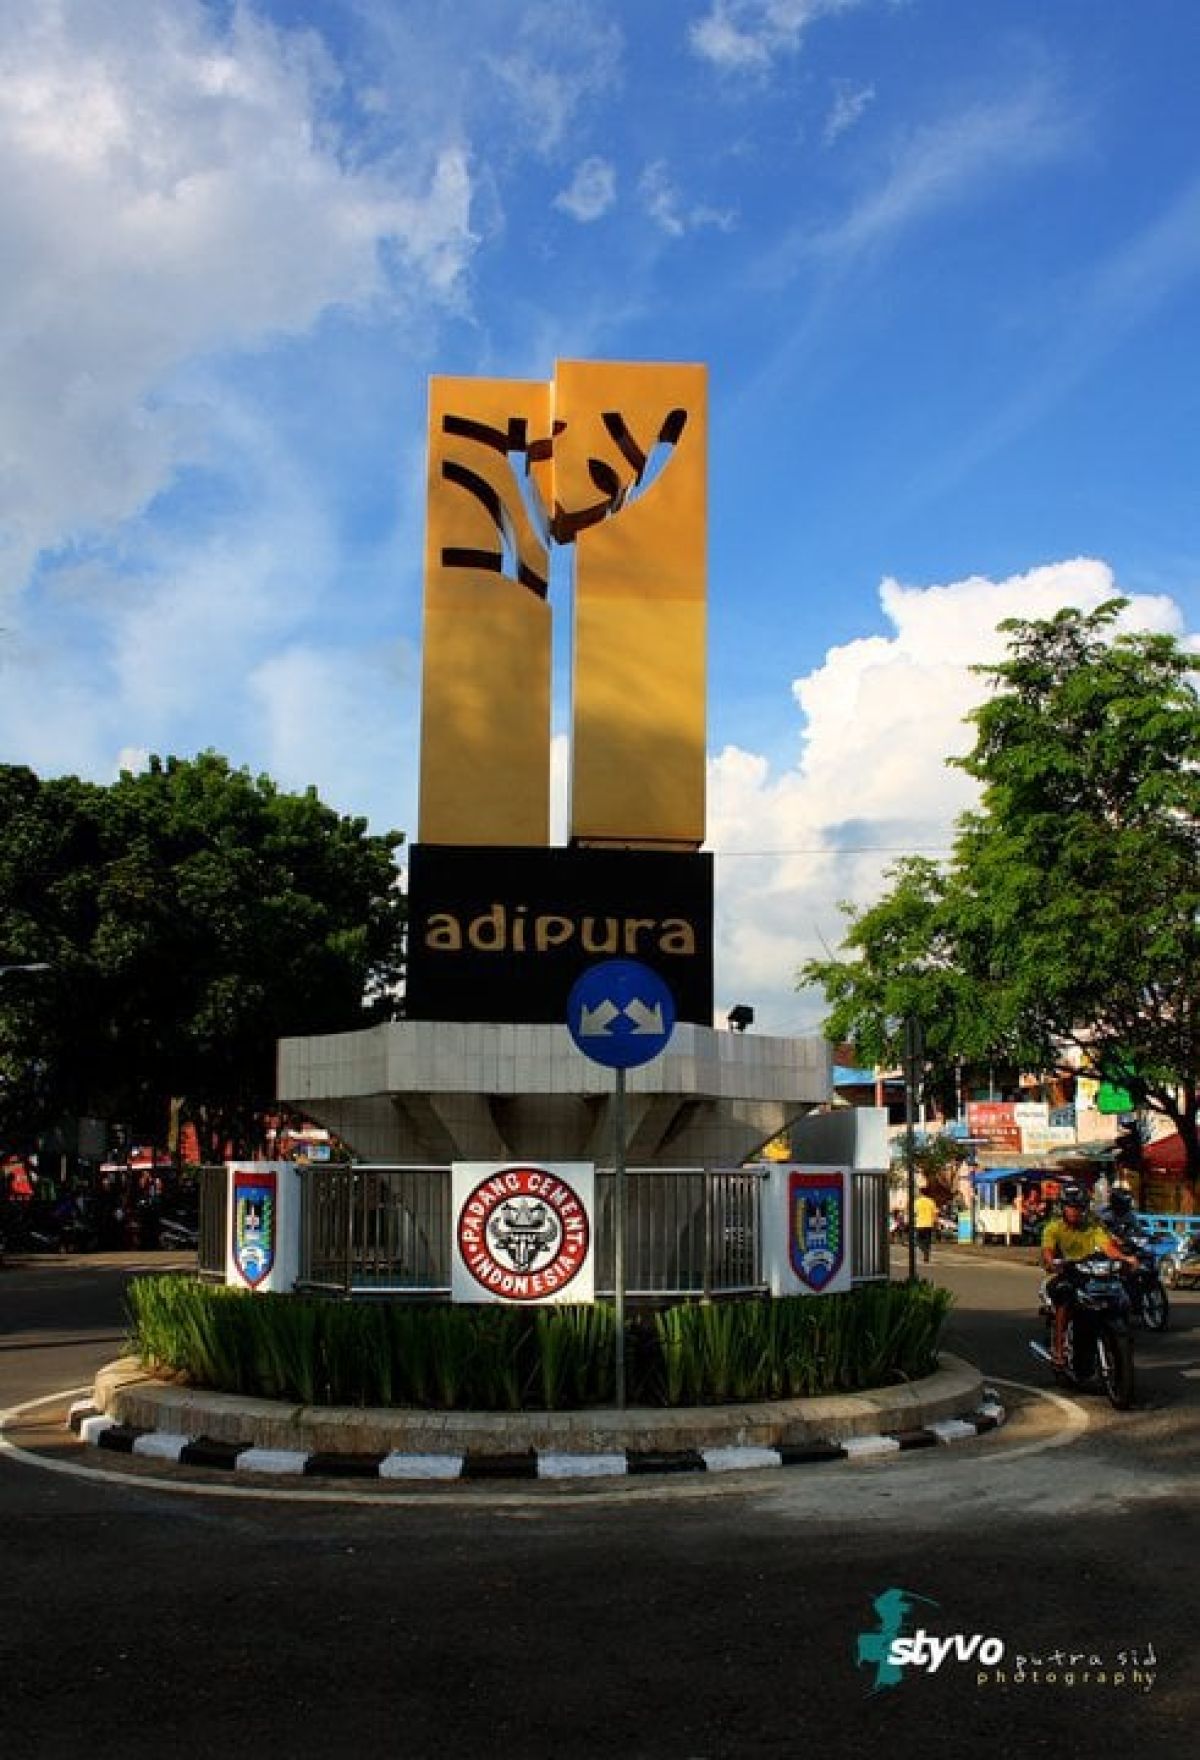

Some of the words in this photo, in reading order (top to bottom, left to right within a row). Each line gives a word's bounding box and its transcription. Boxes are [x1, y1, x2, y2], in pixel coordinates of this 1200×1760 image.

[425, 903, 695, 954] adipura
[463, 1173, 521, 1243] PADANG
[528, 1173, 584, 1244] CEMENT
[471, 1253, 575, 1294] INDONESIA
